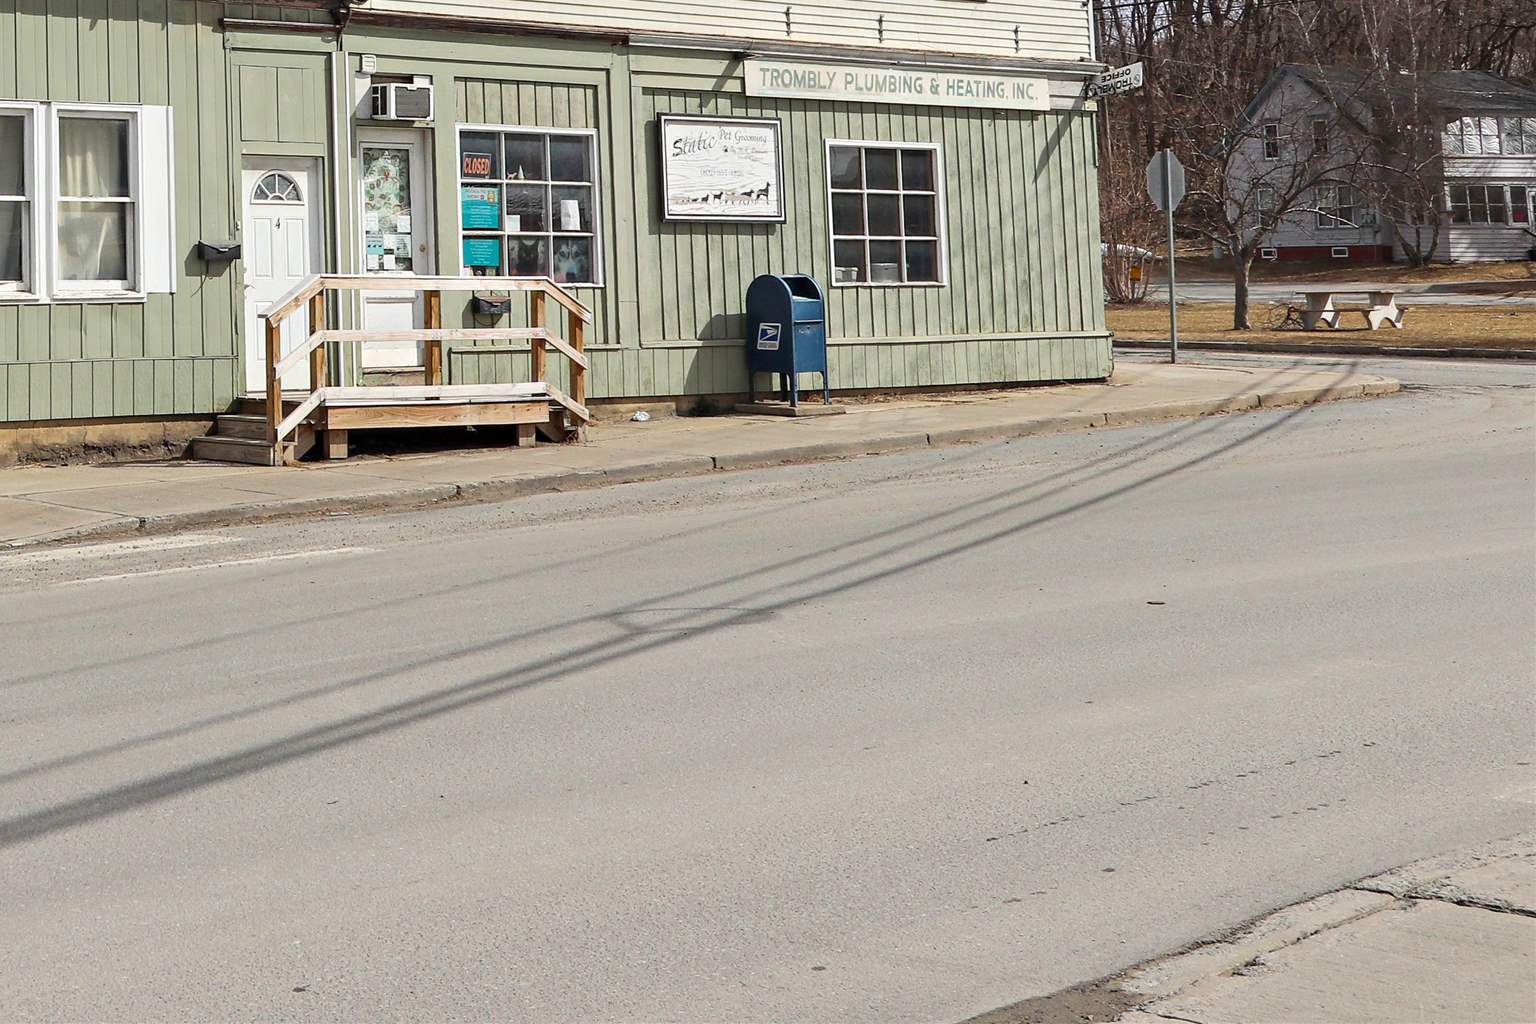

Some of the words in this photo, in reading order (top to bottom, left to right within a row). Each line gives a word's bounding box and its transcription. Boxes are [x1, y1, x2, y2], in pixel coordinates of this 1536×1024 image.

[759, 68, 836, 90] TROMBLY
[844, 72, 924, 95] PLUMBING
[929, 78, 940, 96] &
[1012, 83, 1038, 100] INC.
[1101, 68, 1131, 83] OFFICE
[672, 131, 718, 157] Static
[719, 129, 731, 141] Pet
[734, 130, 768, 144] Grooming
[464, 157, 490, 174] CLOSED
[274, 217, 281, 229] 4
